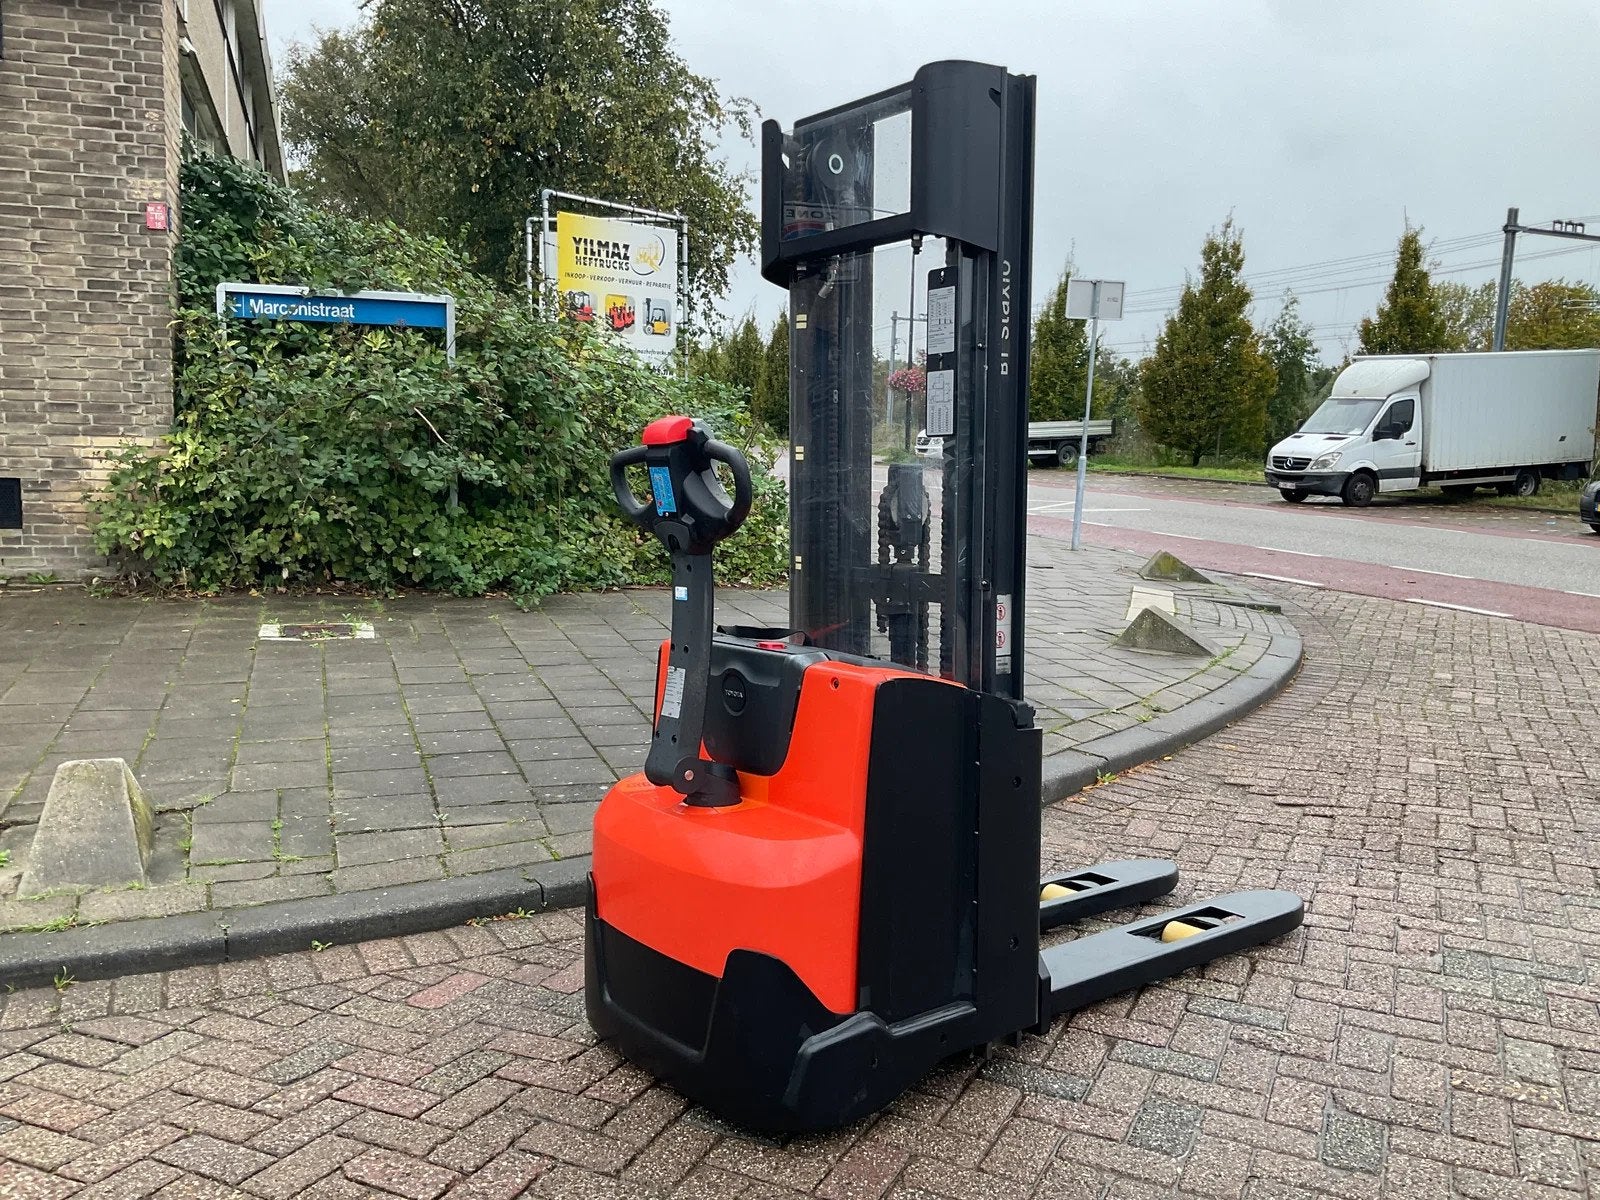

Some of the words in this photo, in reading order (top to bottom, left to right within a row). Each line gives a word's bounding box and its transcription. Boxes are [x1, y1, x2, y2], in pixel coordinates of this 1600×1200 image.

[572, 236, 630, 261] YILMAZ
[575, 255, 630, 271] HEFTRUCKS
[564, 271, 586, 280] INKOOP
[589, 274, 615, 283] VERKOOP
[645, 280, 672, 290] REPARATIE
